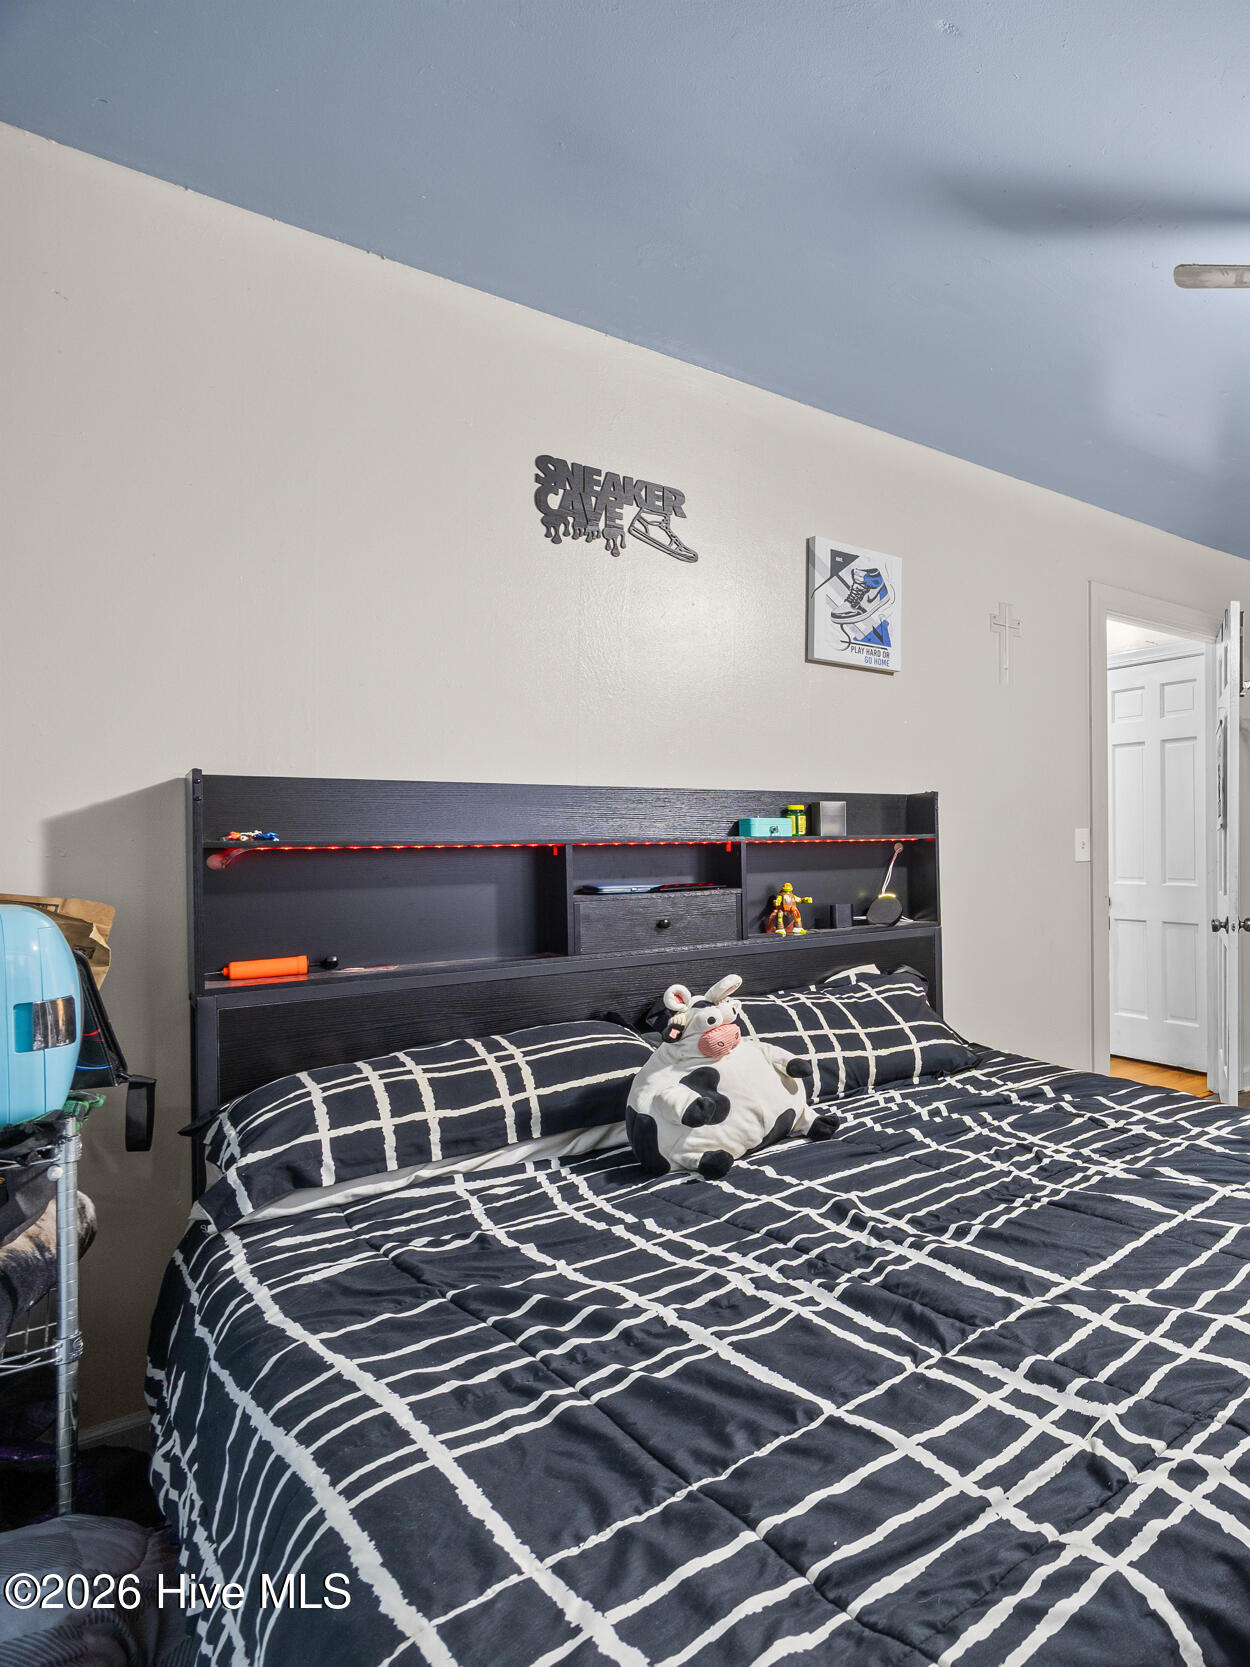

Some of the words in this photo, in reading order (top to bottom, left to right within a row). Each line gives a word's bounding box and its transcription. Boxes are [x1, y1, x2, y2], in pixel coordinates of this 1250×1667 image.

[534, 454, 687, 518] SNEAKER
[534, 481, 624, 538] CAVE
[851, 646, 865, 655] PLAY
[866, 648, 881, 658] HARD
[882, 650, 890, 659] OR
[864, 656, 873, 664] GO
[874, 657, 890, 667] HOME
